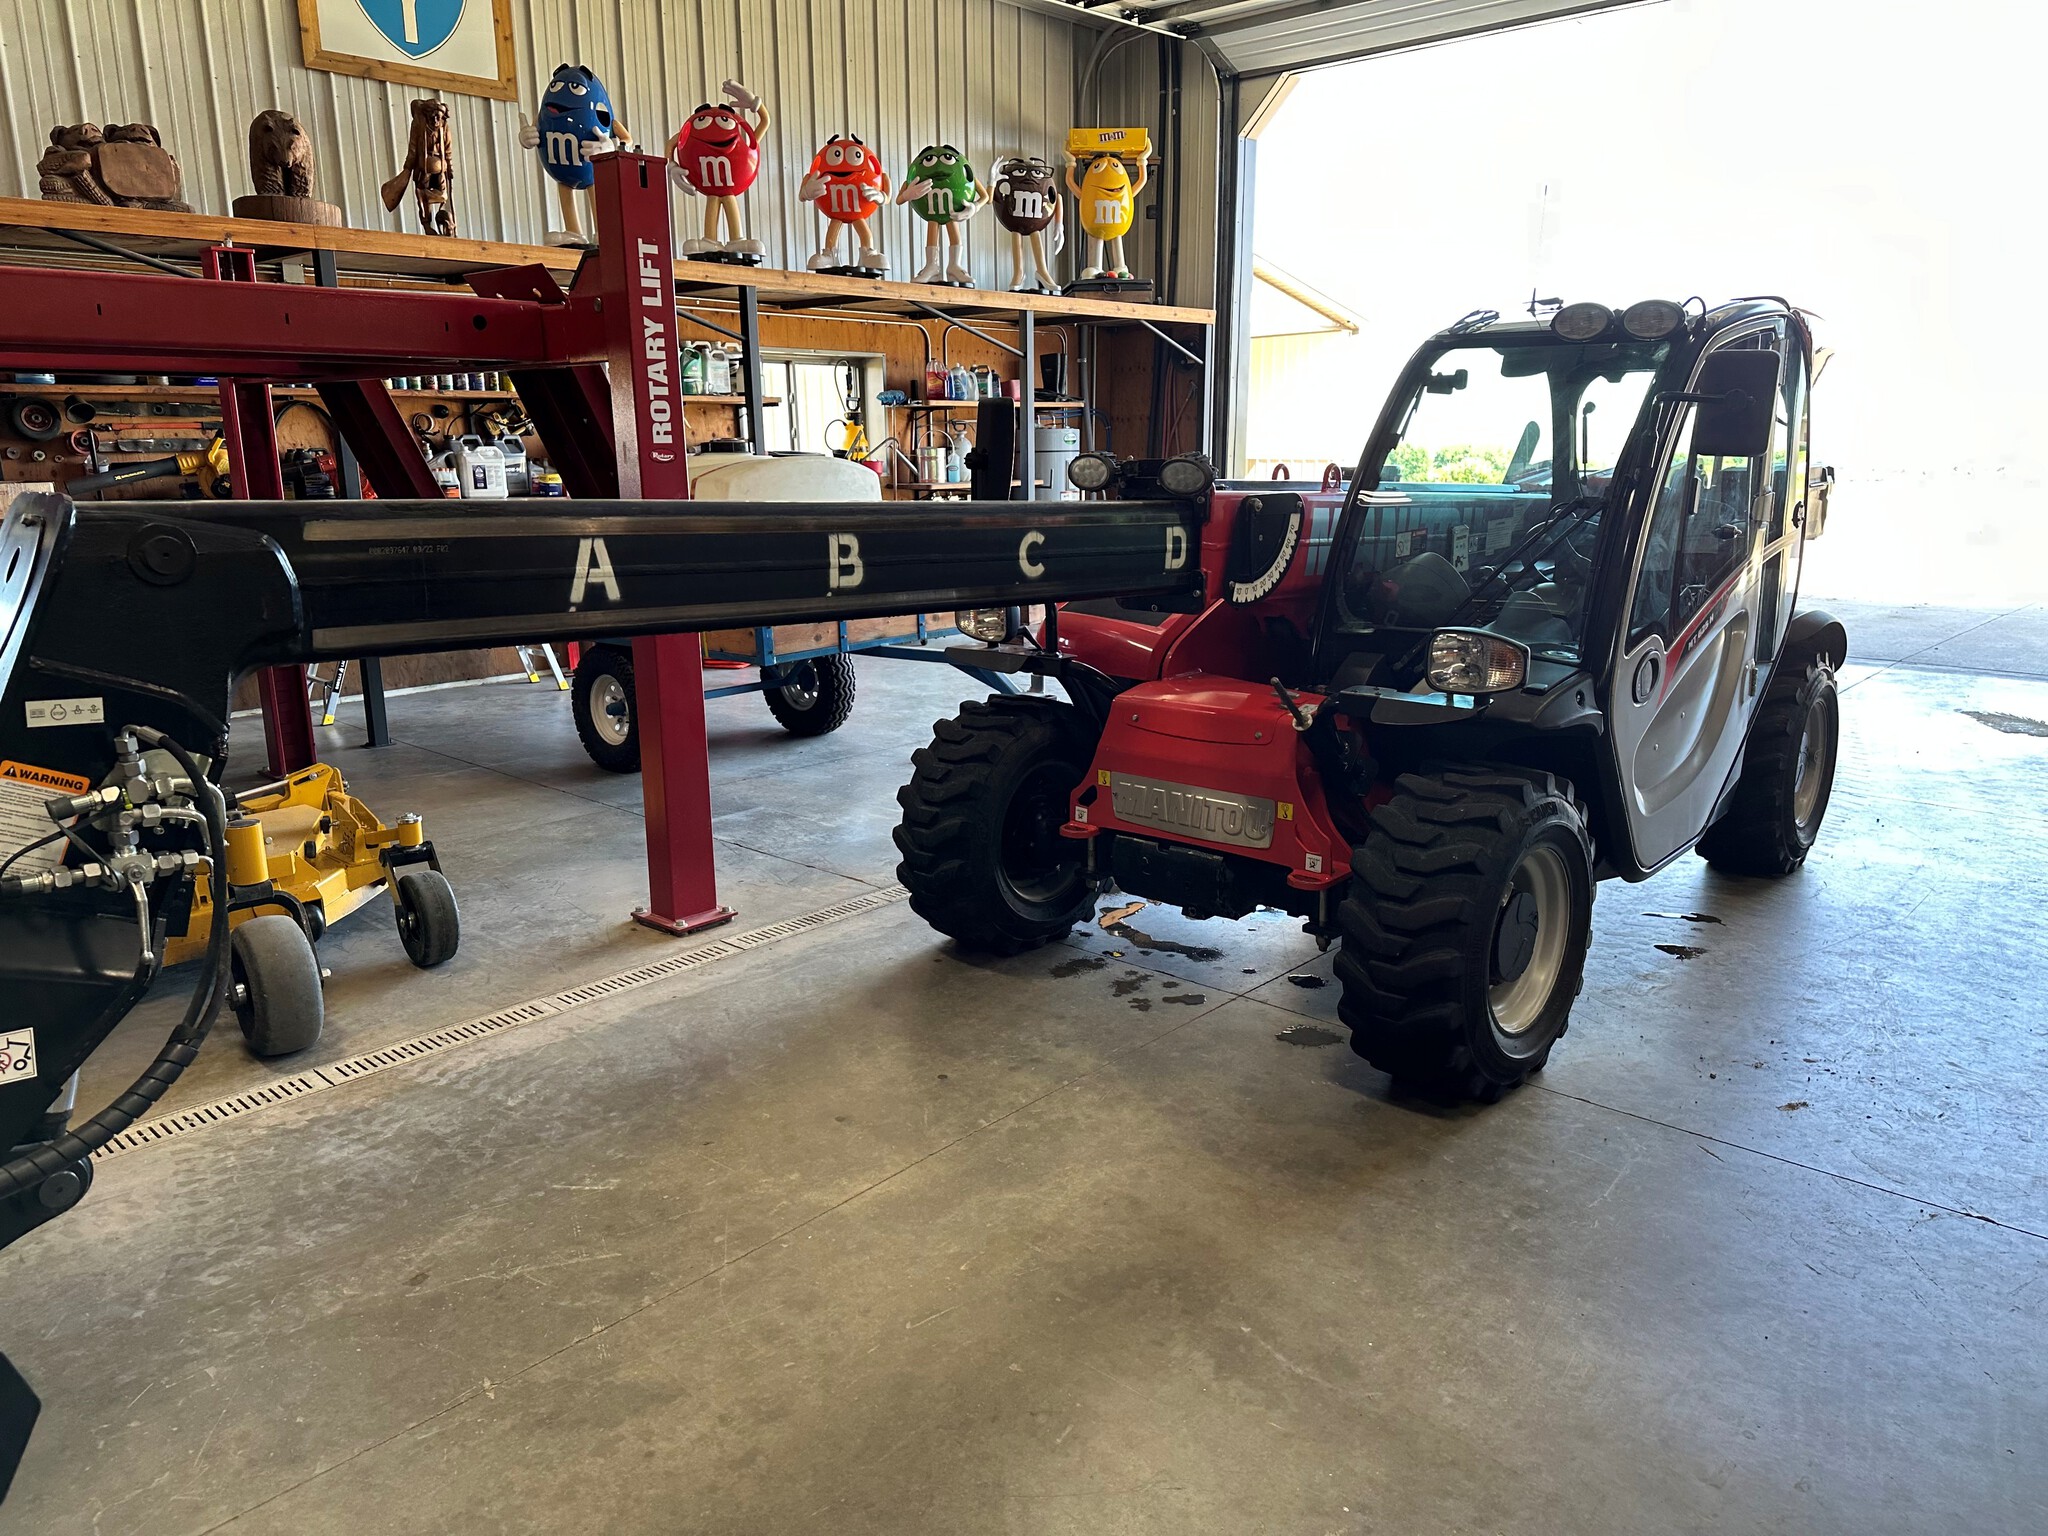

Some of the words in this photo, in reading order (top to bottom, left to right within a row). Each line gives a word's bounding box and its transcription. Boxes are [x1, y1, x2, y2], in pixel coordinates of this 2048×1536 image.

[638, 237, 663, 307] LIFT
[643, 315, 673, 444] ROTARY
[569, 537, 621, 603] A
[828, 533, 864, 589] B
[1018, 530, 1045, 577] C
[1164, 526, 1187, 569] D
[19, 768, 84, 791] WARNING
[1114, 781, 1270, 841] MANITOU
